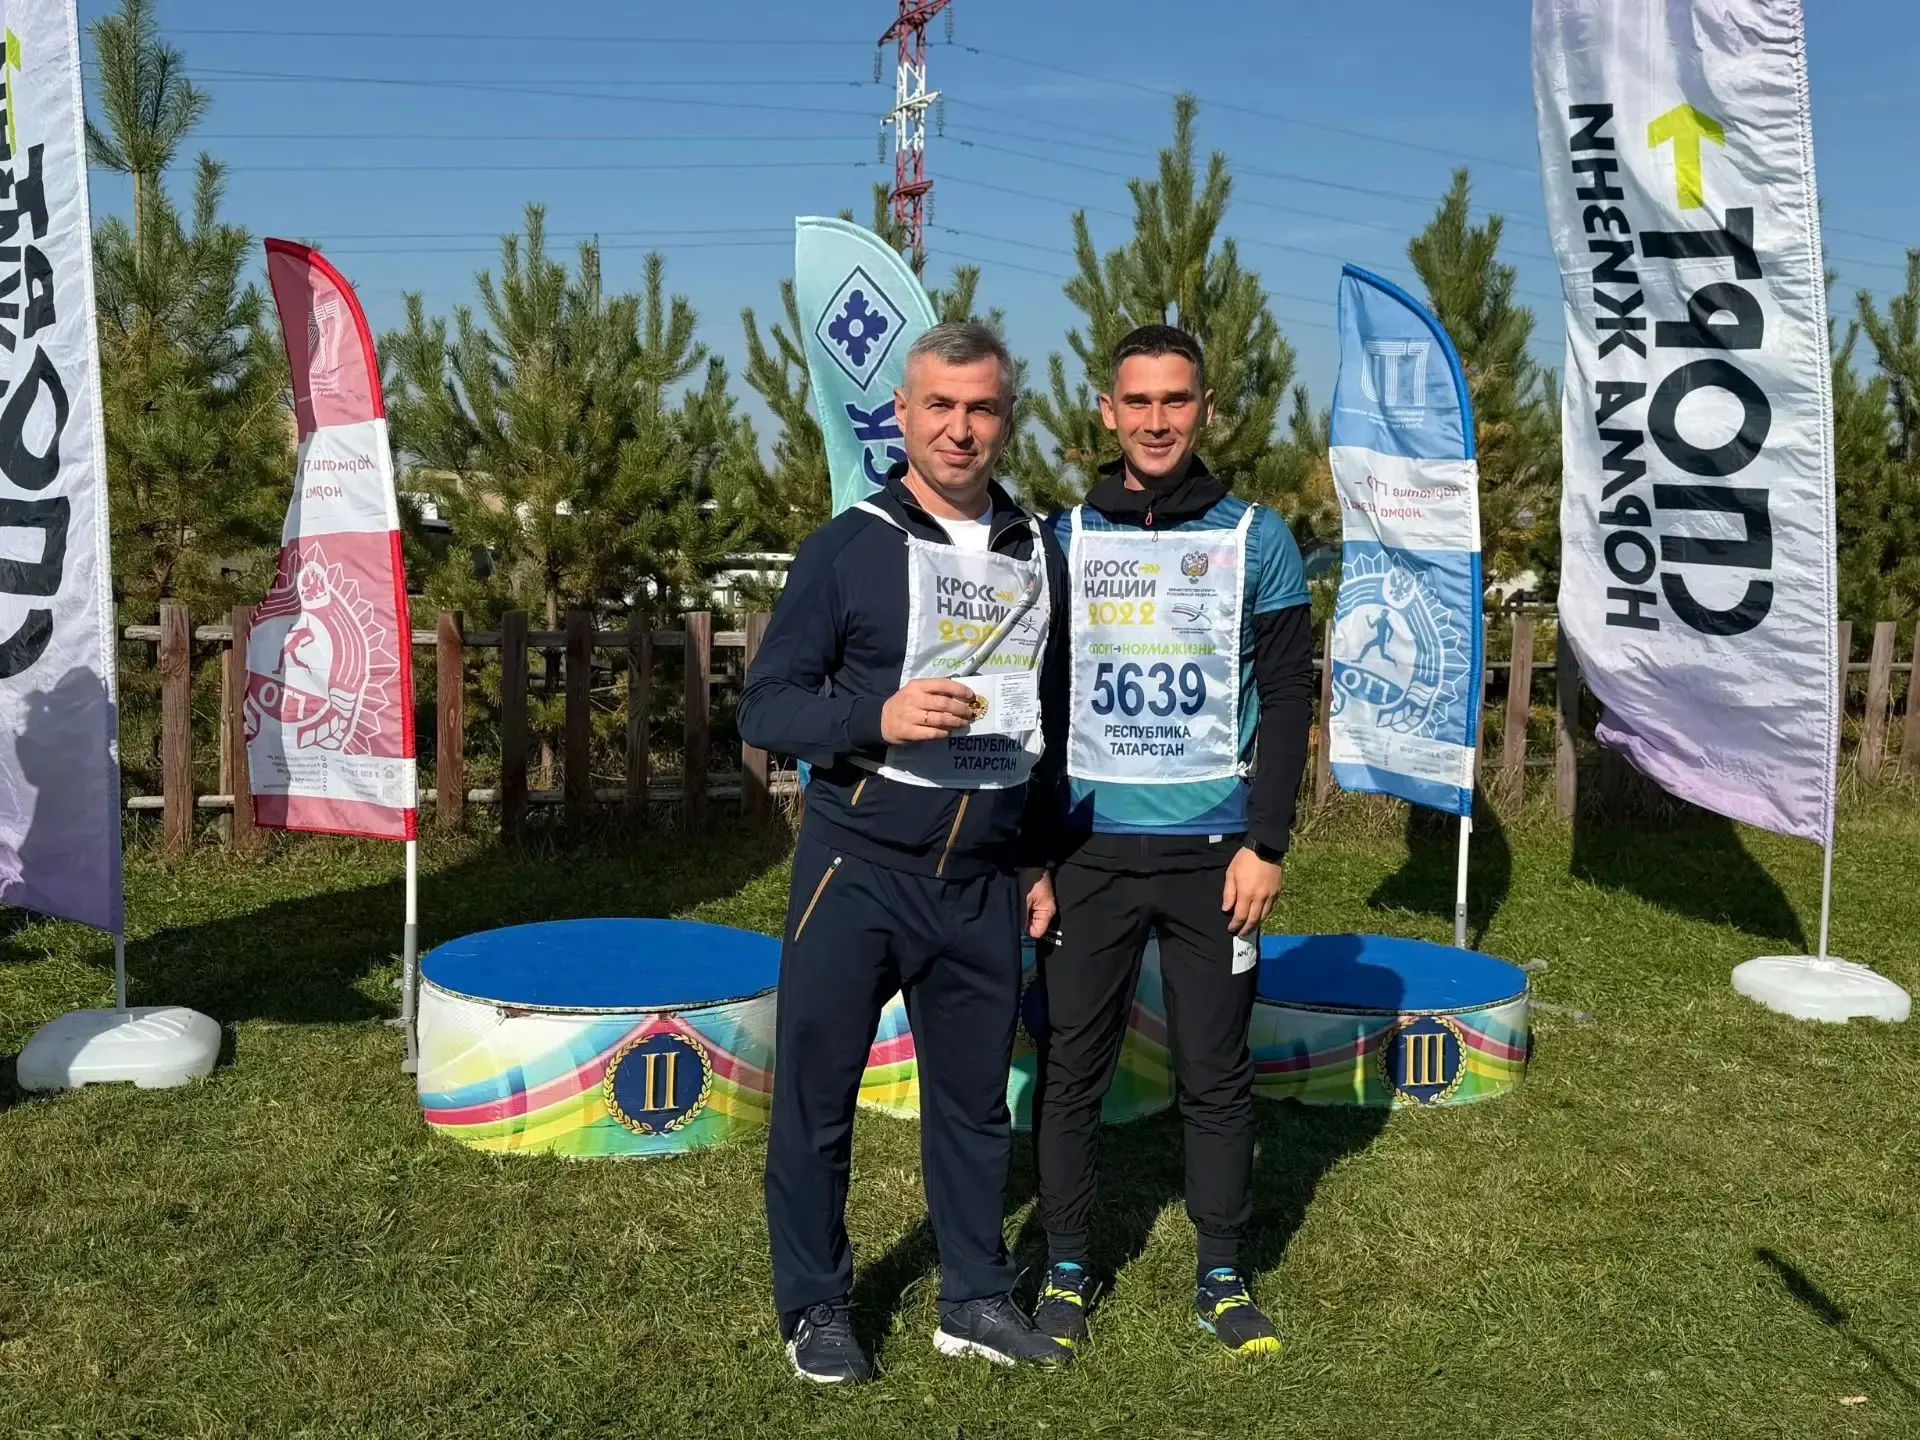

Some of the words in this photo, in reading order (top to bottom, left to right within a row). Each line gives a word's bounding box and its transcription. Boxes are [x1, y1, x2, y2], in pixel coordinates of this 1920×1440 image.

[1084, 559, 1139, 578] КРОСС
[936, 575, 997, 603] КРОСС
[1084, 579, 1157, 600] НАЦИИ
[1088, 600, 1157, 626] 2022
[1091, 662, 1207, 717] 5639
[1104, 724, 1192, 739] РЕСПУБЛИКА
[948, 737, 1022, 752] РЕСПУБЛИКА
[1110, 742, 1185, 756] ТАТАРСТАН
[953, 755, 1017, 771] ТАТАРСТАН
[1402, 1033, 1447, 1086] III
[640, 1052, 680, 1112] II
